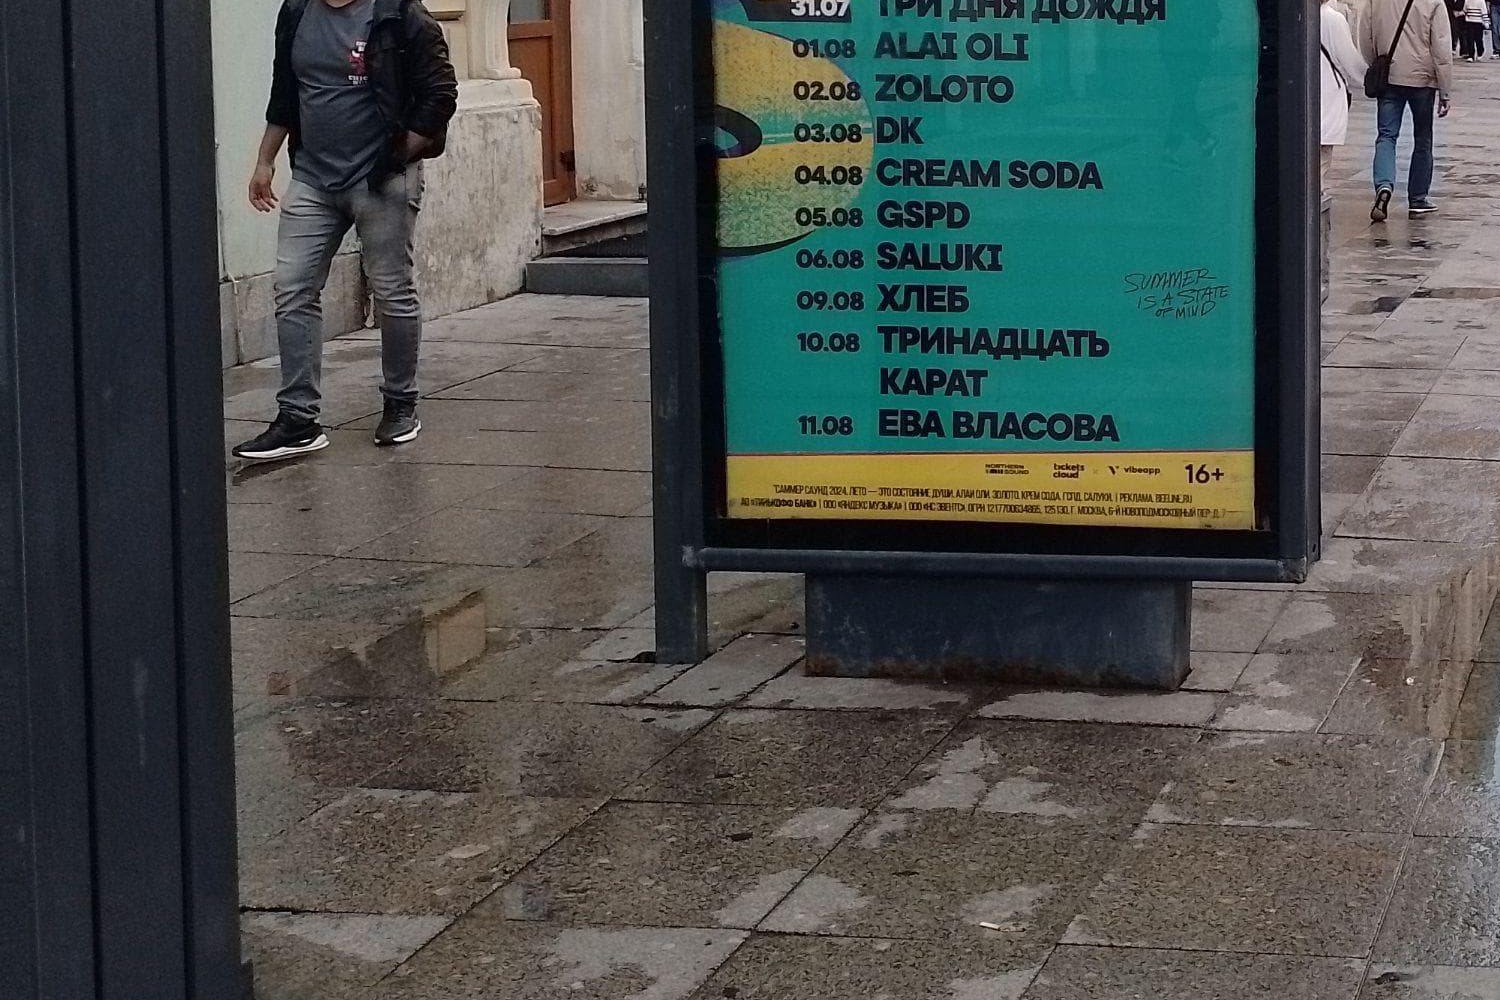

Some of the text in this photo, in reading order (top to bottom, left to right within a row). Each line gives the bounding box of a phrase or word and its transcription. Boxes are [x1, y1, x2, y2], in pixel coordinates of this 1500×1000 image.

[792, 33, 1029, 61] 01.08 ALAI OLI
[793, 74, 1014, 103] 02.08 ZOLOTO
[794, 117, 923, 145] 03.08 DK
[794, 159, 1103, 190] 04.08 CREAM SODA
[795, 201, 970, 229] 05.08 GSPD
[795, 243, 1003, 272] 06.08 SALUKI
[1124, 268, 1217, 293] SUMMER
[796, 284, 970, 313] 09.08 ХЛЕБ
[1137, 285, 1230, 310] IS A STATE
[1155, 301, 1216, 318] OF MIND
[797, 326, 1110, 360] 10.08 ТРИНАДЦАТЬ
[880, 368, 988, 398] КАРАТ
[798, 408, 1120, 442] 11.08 ЕВА ВЛАСОВА
[1053, 463, 1085, 471] tickets
[1053, 471, 1079, 479] cloud
[1124, 466, 1161, 475] vibeapp
[1184, 464, 1224, 484] 16+
